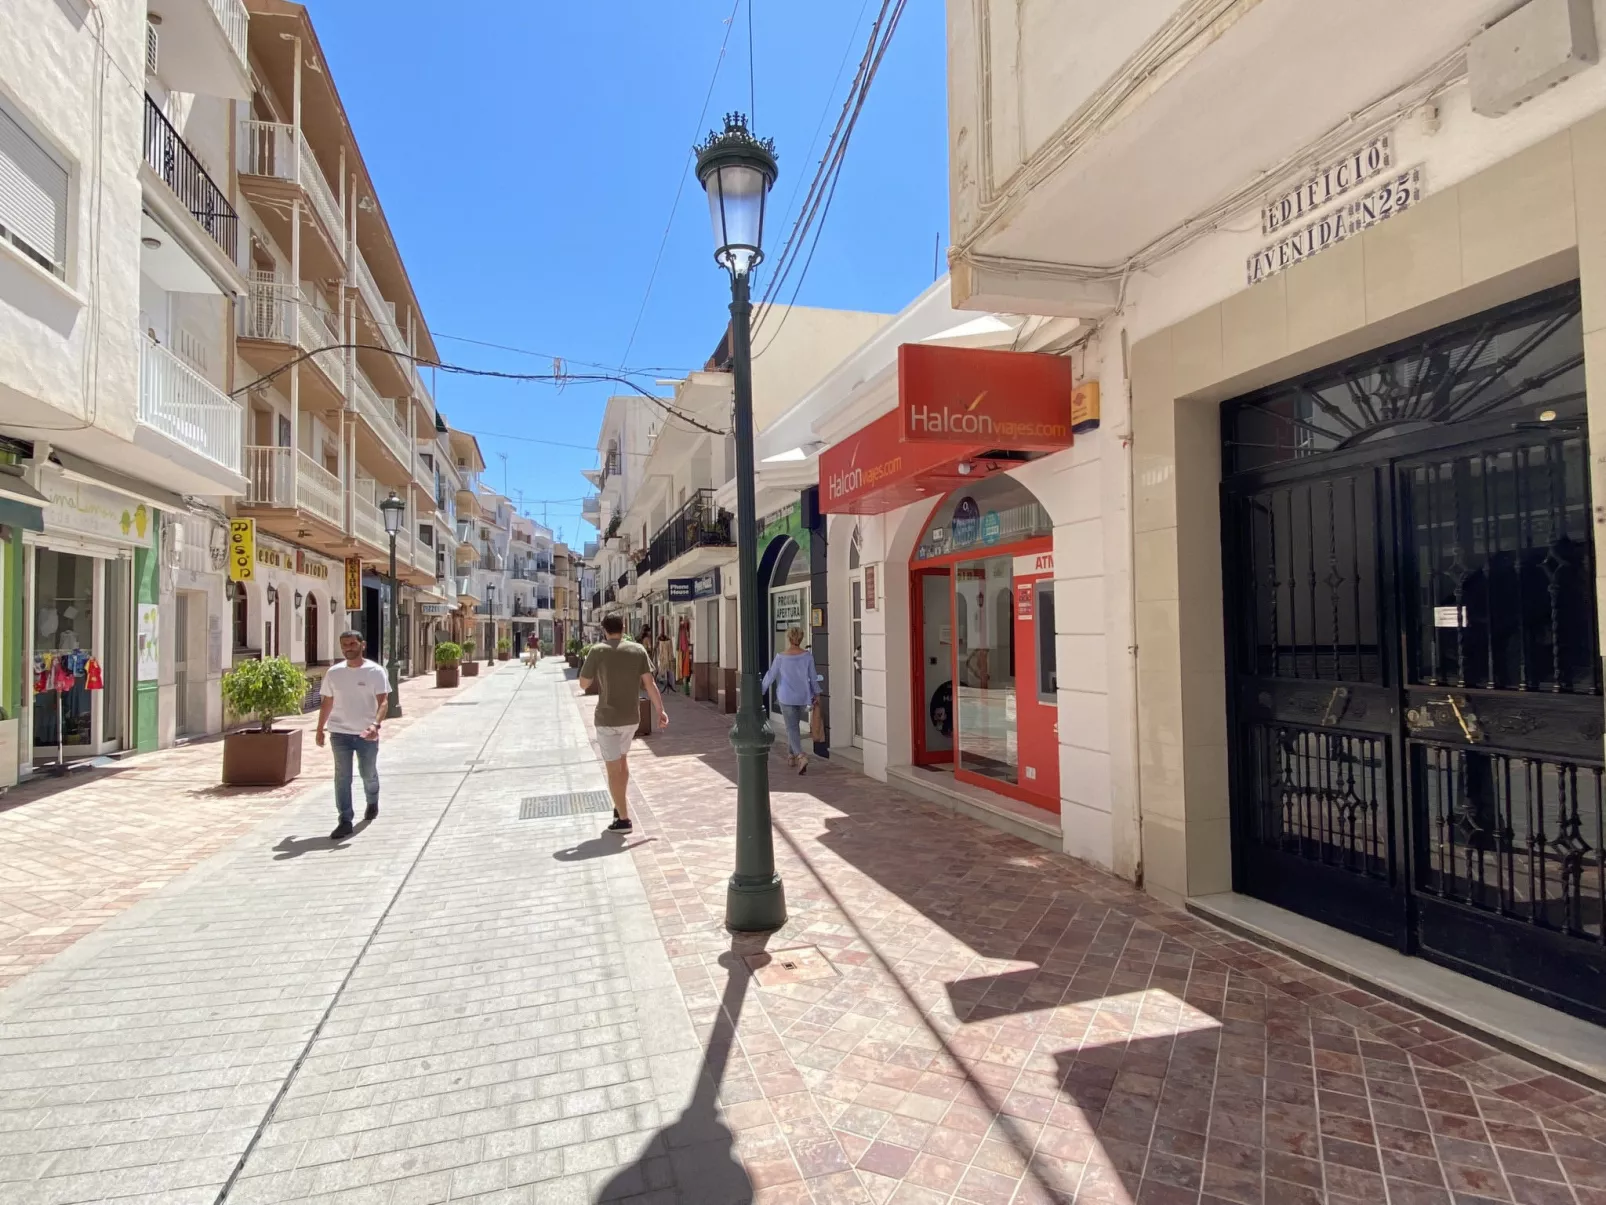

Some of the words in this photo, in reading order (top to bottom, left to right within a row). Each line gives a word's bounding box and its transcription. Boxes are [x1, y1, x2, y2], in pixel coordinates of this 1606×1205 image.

[1268, 146, 1380, 229] EDIFICIO
[1253, 214, 1347, 280] AVENIDA
[776, 606, 800, 619] APERTURA
